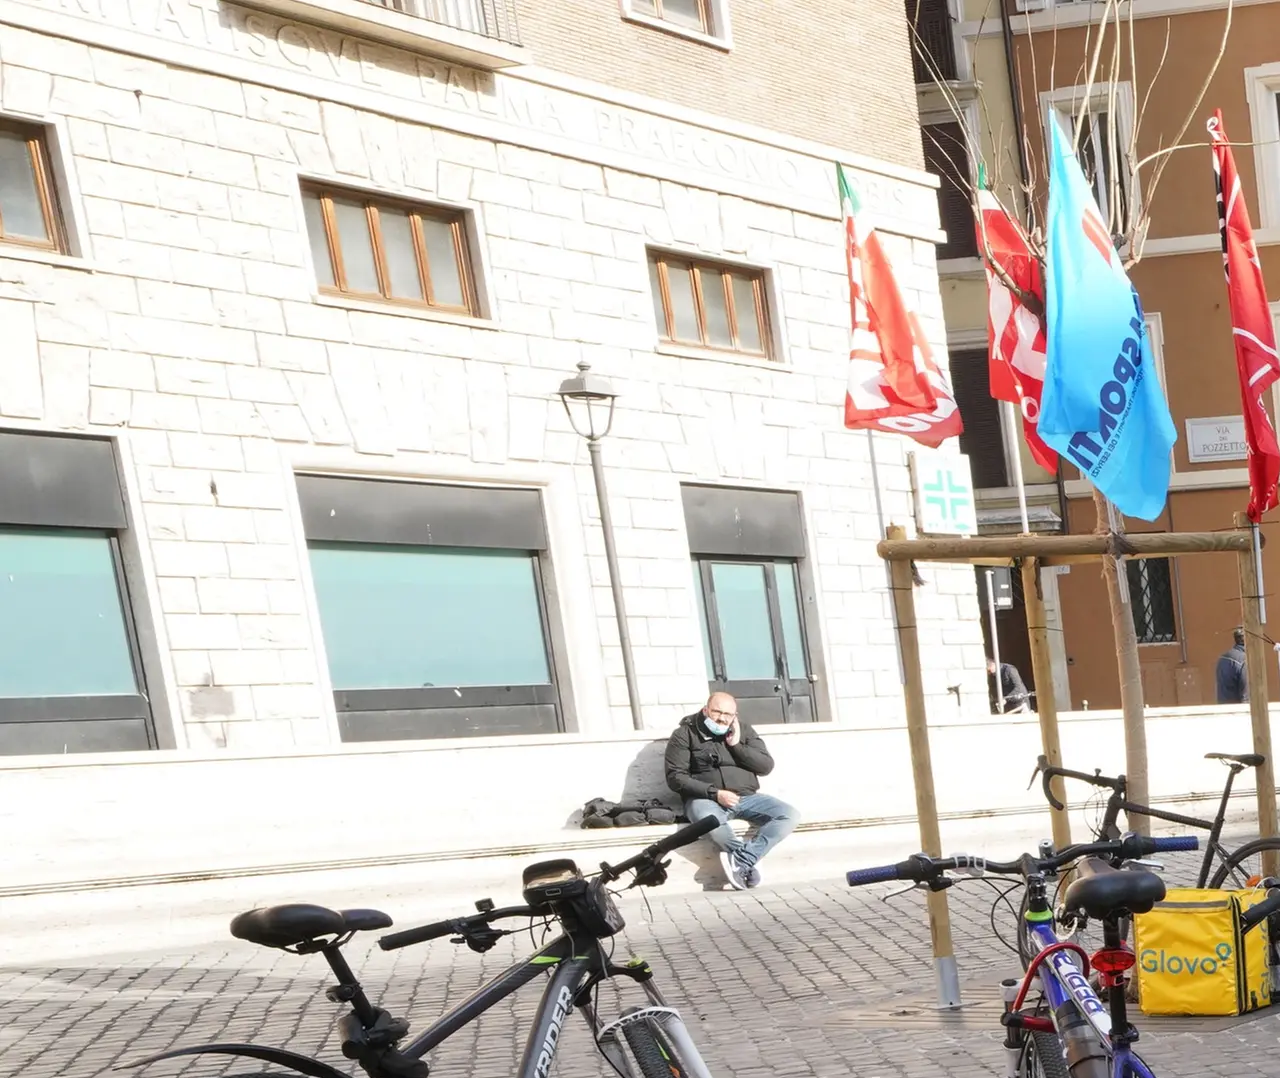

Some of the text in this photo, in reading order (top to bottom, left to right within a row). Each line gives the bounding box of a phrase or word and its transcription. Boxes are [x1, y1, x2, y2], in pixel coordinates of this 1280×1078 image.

[1215, 425, 1231, 434] VIA
[1202, 441, 1247, 453] POZZETTO
[1140, 949, 1218, 975] Glovo
